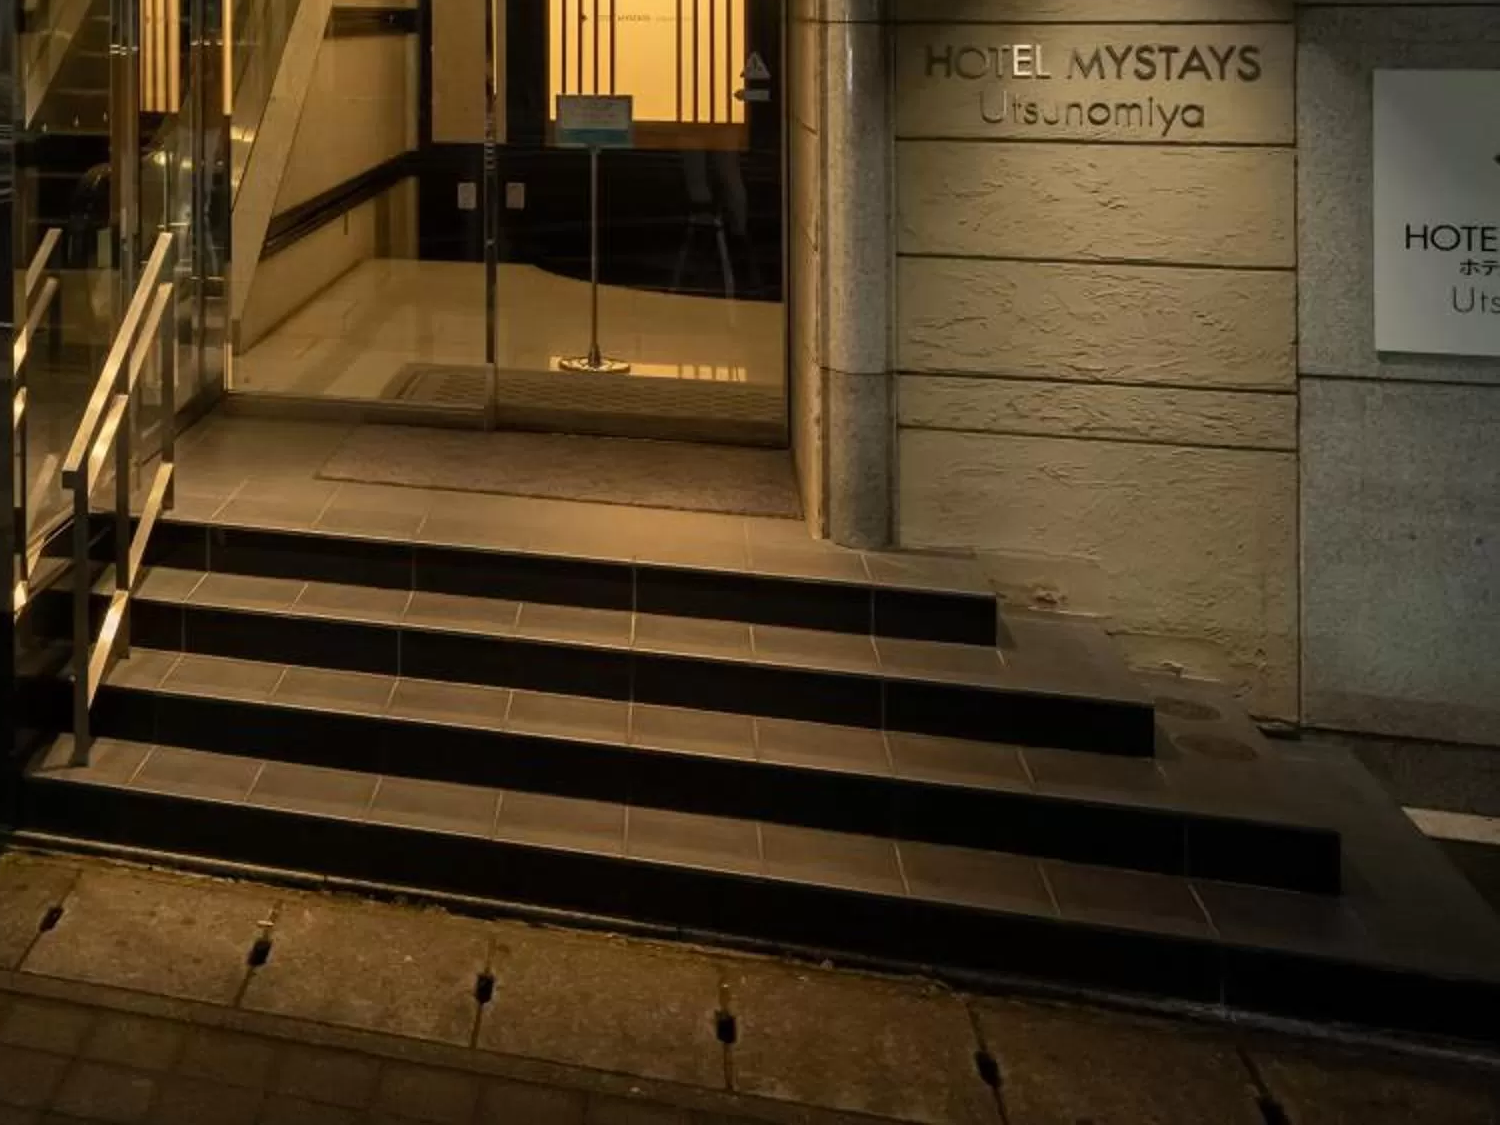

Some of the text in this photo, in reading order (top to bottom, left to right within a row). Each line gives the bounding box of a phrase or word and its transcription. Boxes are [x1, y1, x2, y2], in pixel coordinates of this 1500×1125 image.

[924, 43, 1262, 82] HOTEL MYSTAYS
[979, 90, 1206, 137] Utsunomiya
[1405, 224, 1498, 252] HOTE
